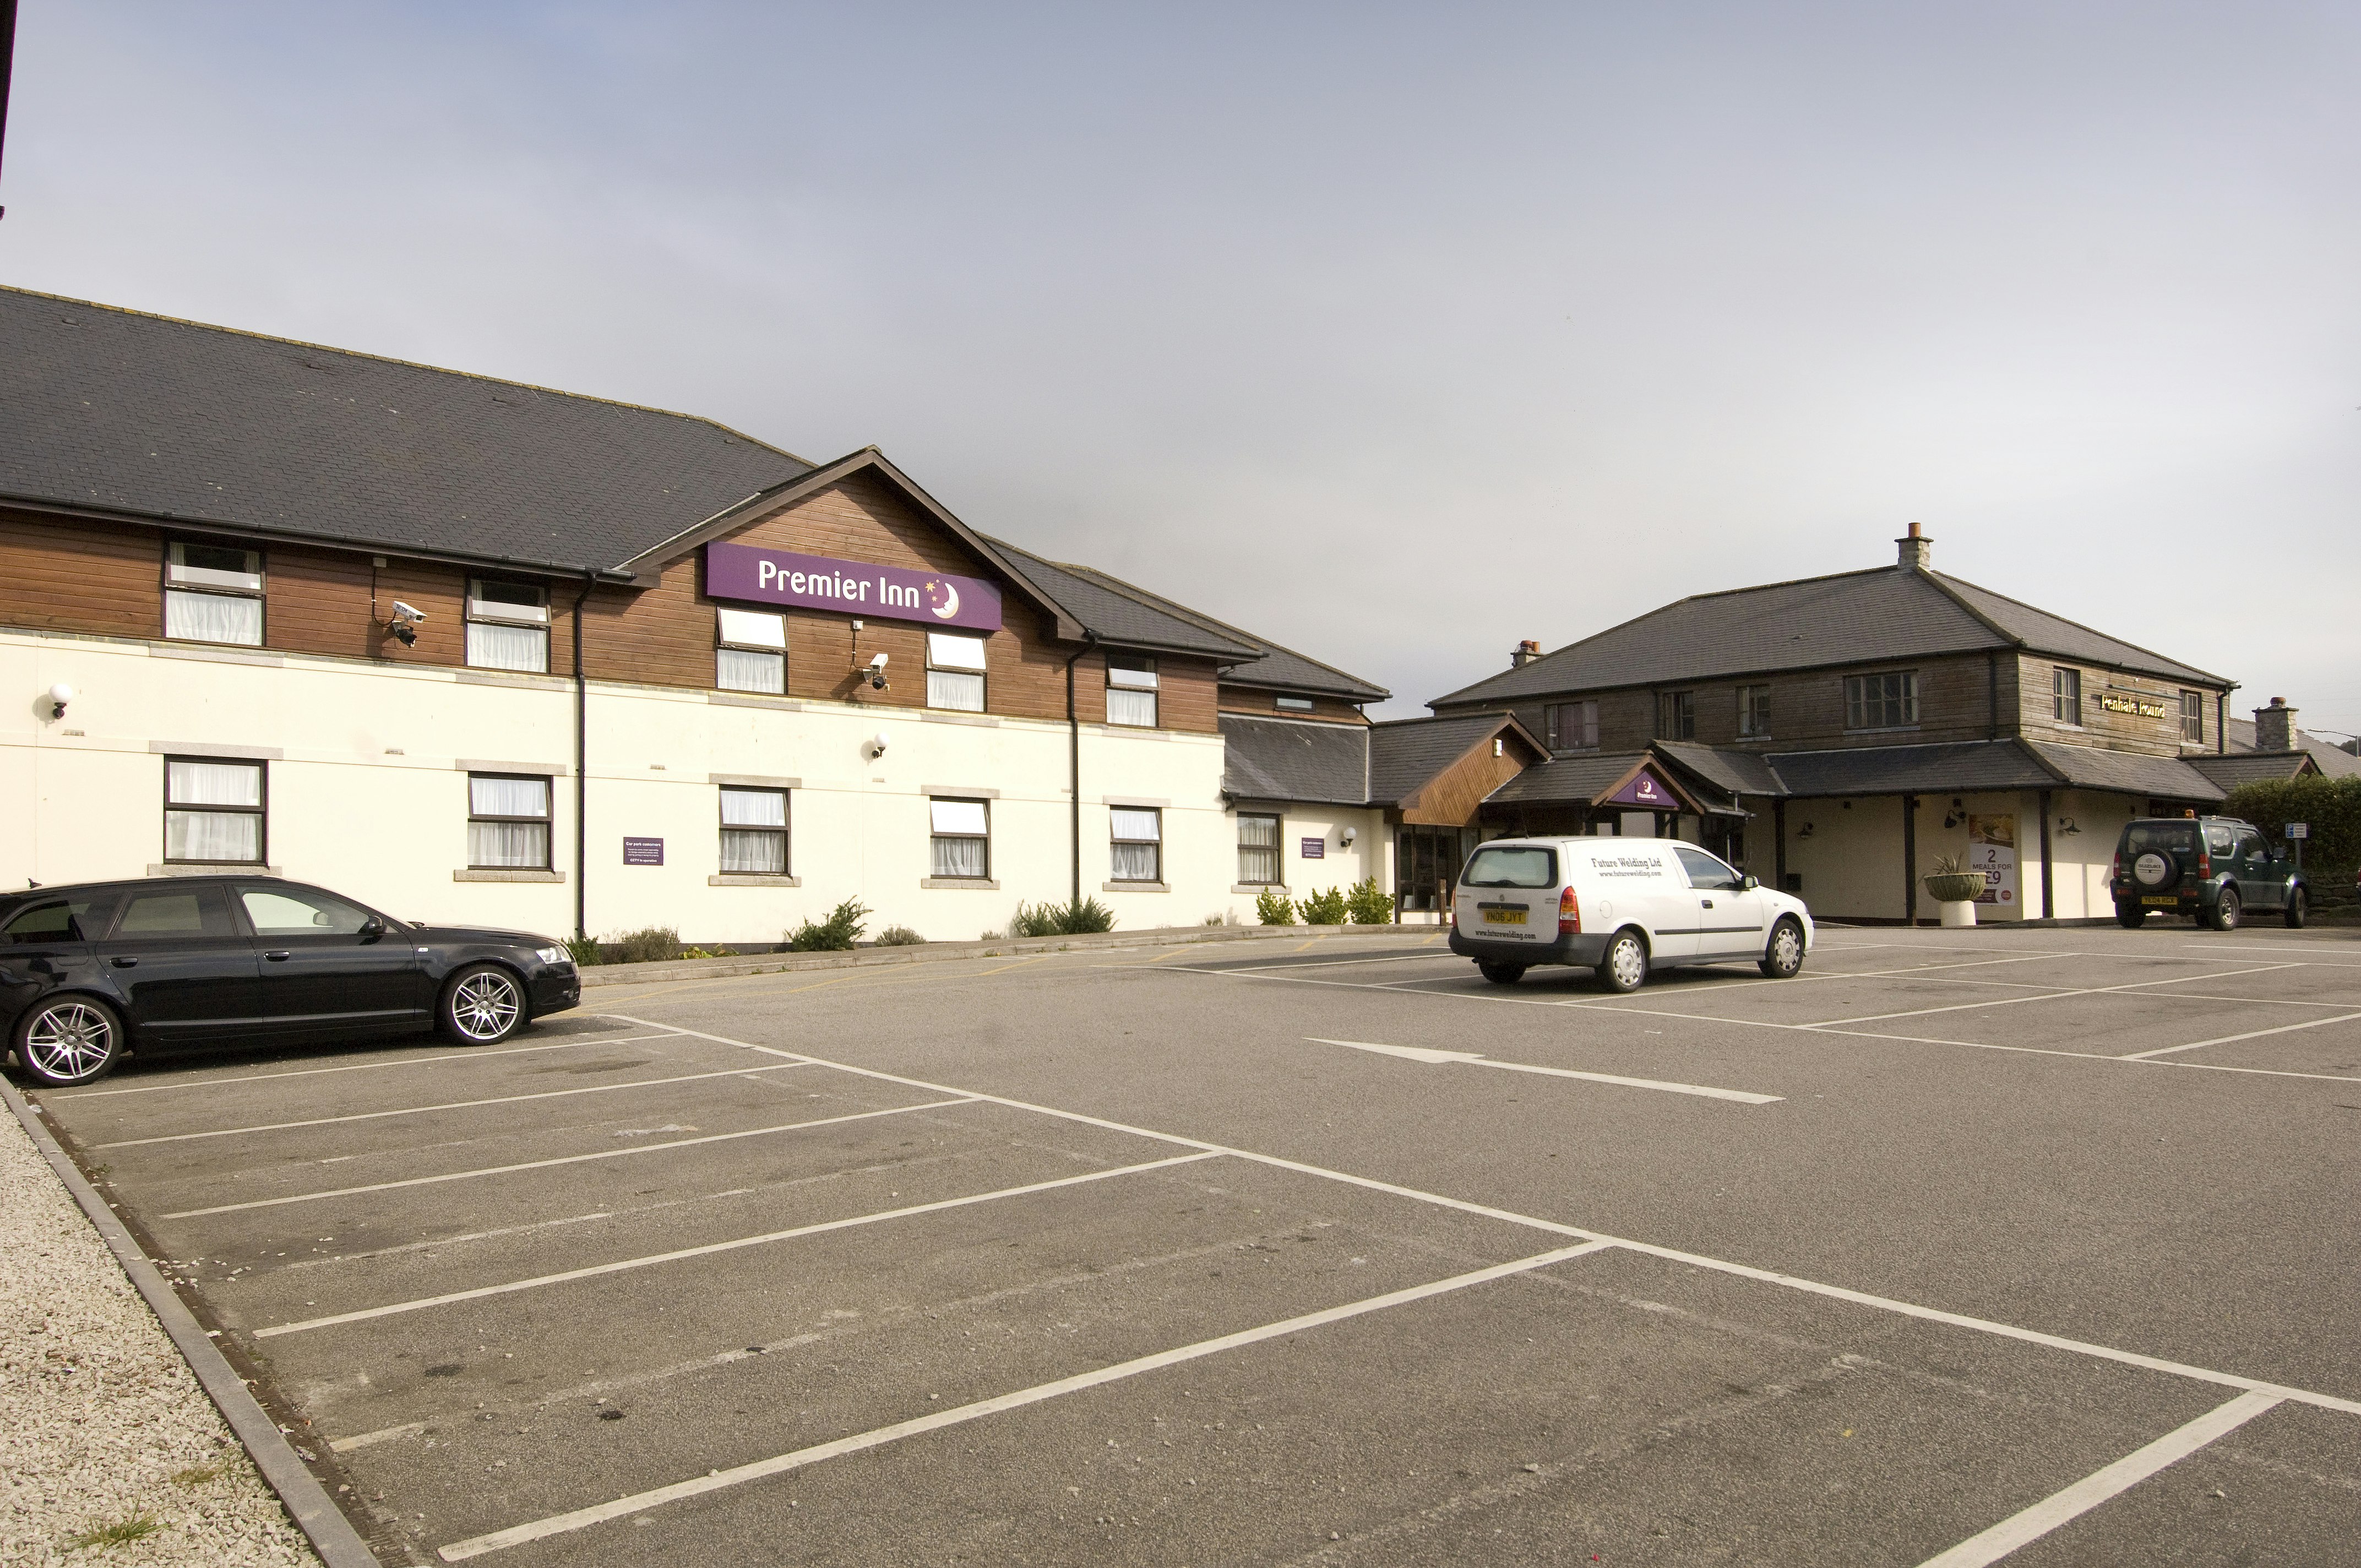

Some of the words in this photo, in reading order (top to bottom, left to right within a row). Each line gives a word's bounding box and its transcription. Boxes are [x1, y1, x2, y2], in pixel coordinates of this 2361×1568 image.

[759, 560, 871, 601] Premier
[880, 576, 919, 608] Inn
[2102, 695, 2137, 713] Penhale
[2139, 701, 2165, 717] Round
[1988, 849, 1996, 863] 2
[1591, 858, 1618, 867] Future
[1617, 857, 1649, 869] Welding
[1648, 857, 1662, 867] Ltd
[1507, 912, 1522, 922] JYT
[1475, 929, 1536, 940] www.futurewelding.com
